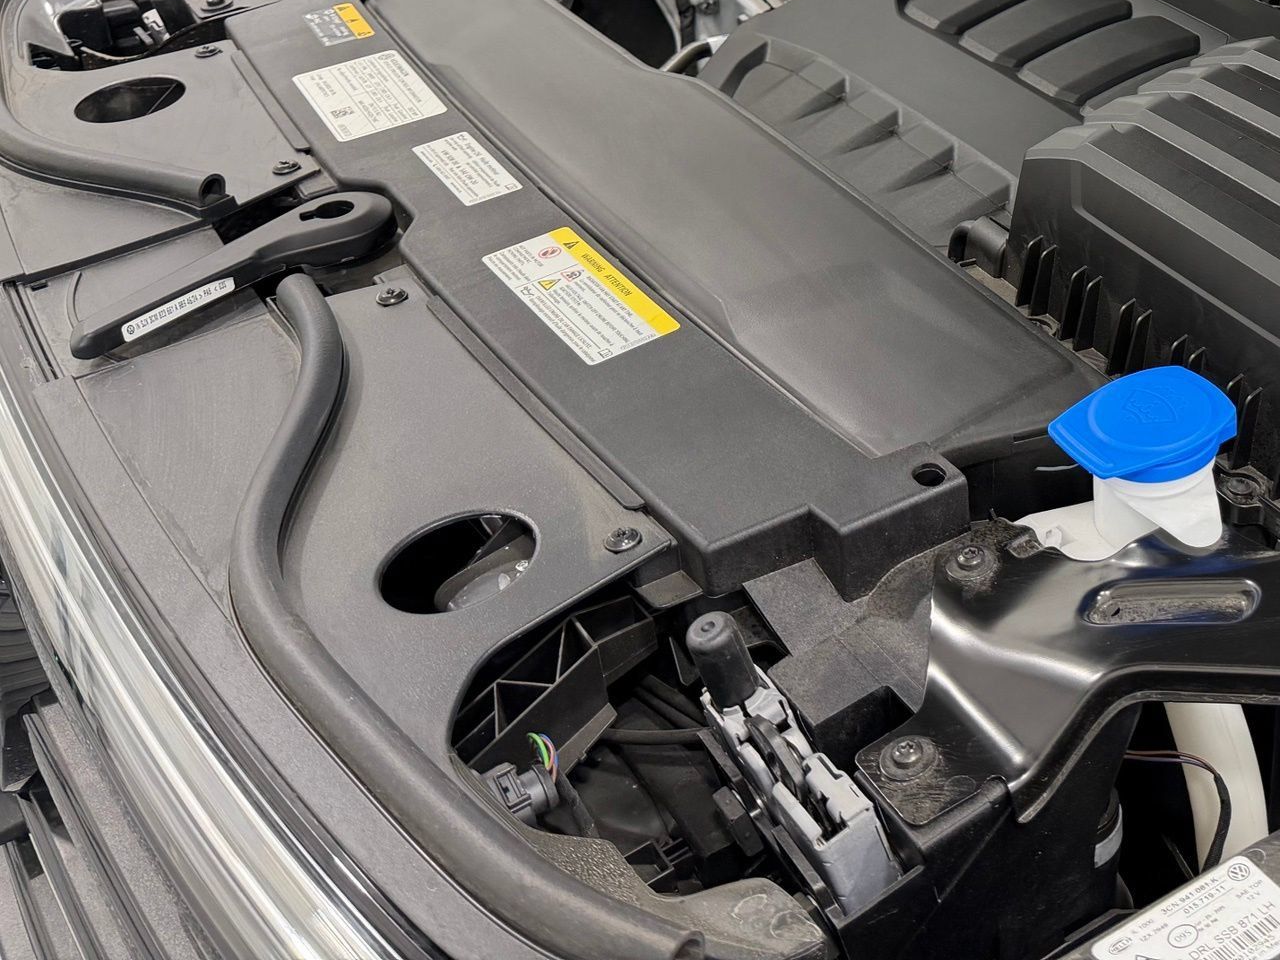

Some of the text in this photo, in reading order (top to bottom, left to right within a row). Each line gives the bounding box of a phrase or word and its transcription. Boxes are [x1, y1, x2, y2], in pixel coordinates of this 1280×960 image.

[604, 274, 633, 297] ATTENTION
[1188, 944, 1215, 960] DRL
[1214, 925, 1239, 945] SSB
[1238, 913, 1257, 929] 871
[1257, 901, 1275, 915] LH
